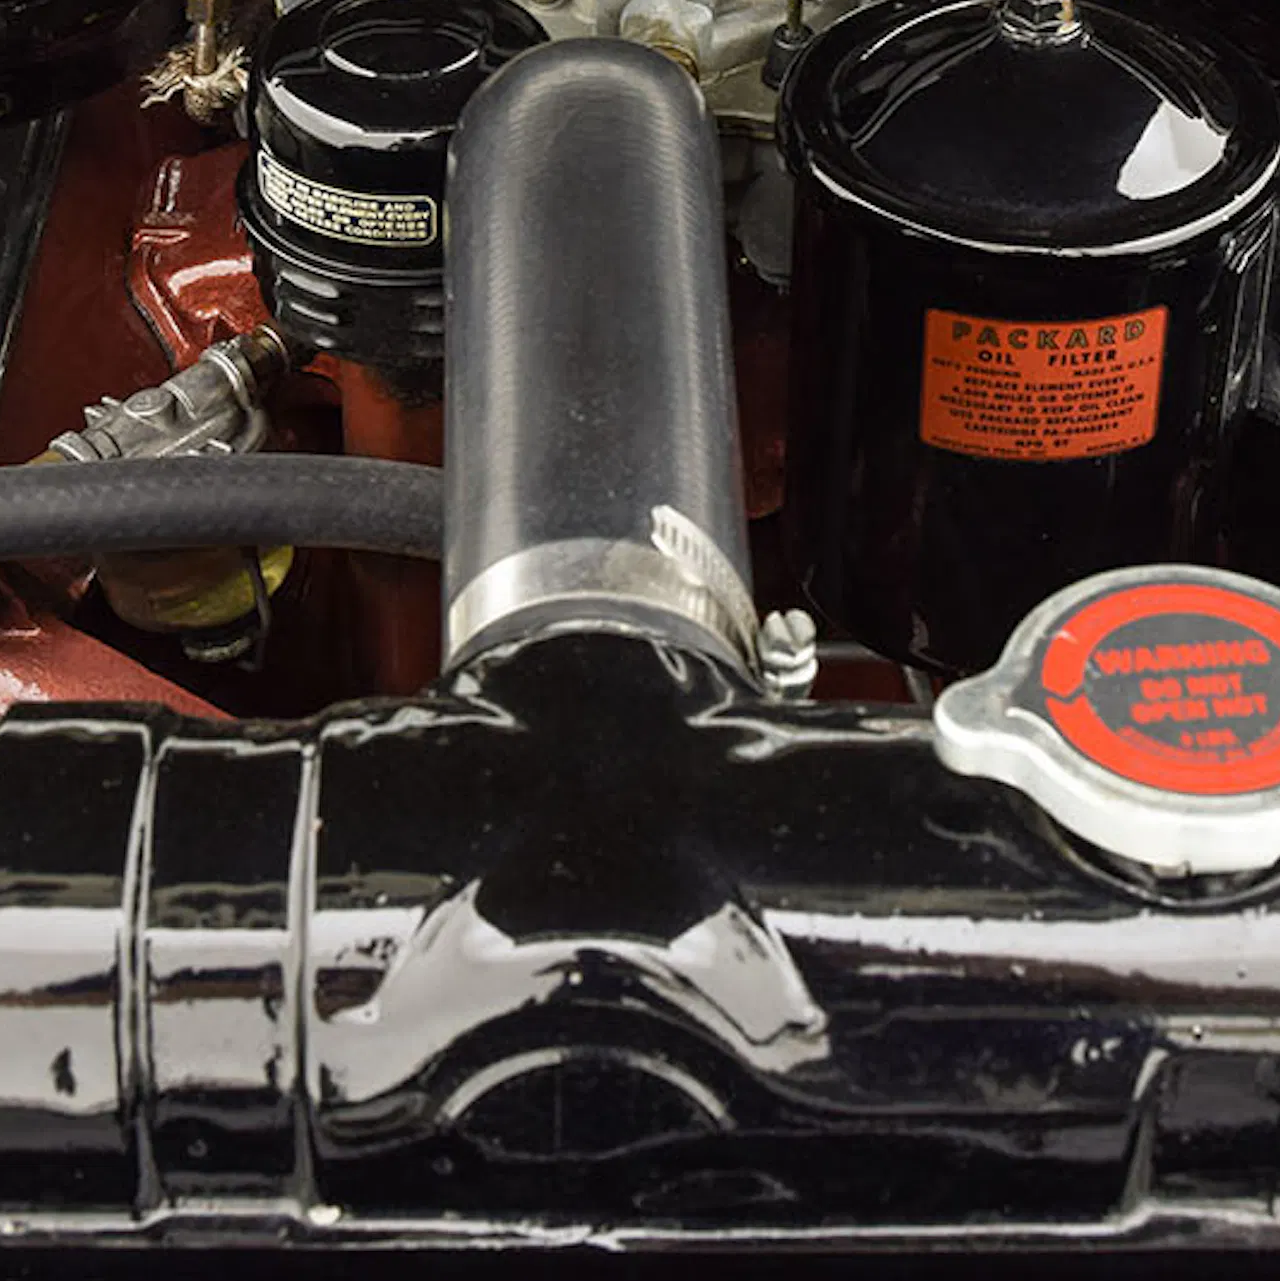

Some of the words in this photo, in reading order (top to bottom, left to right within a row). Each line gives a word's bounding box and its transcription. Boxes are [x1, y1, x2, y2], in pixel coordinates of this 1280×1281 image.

[951, 320, 1146, 350] PACKARD
[977, 349, 1016, 366] OIL
[1047, 348, 1118, 367] FILTER
[1093, 639, 1271, 676] WARNING
[1139, 676, 1183, 700] DO
[1186, 672, 1242, 696] NOT
[1131, 698, 1209, 724] OPEN
